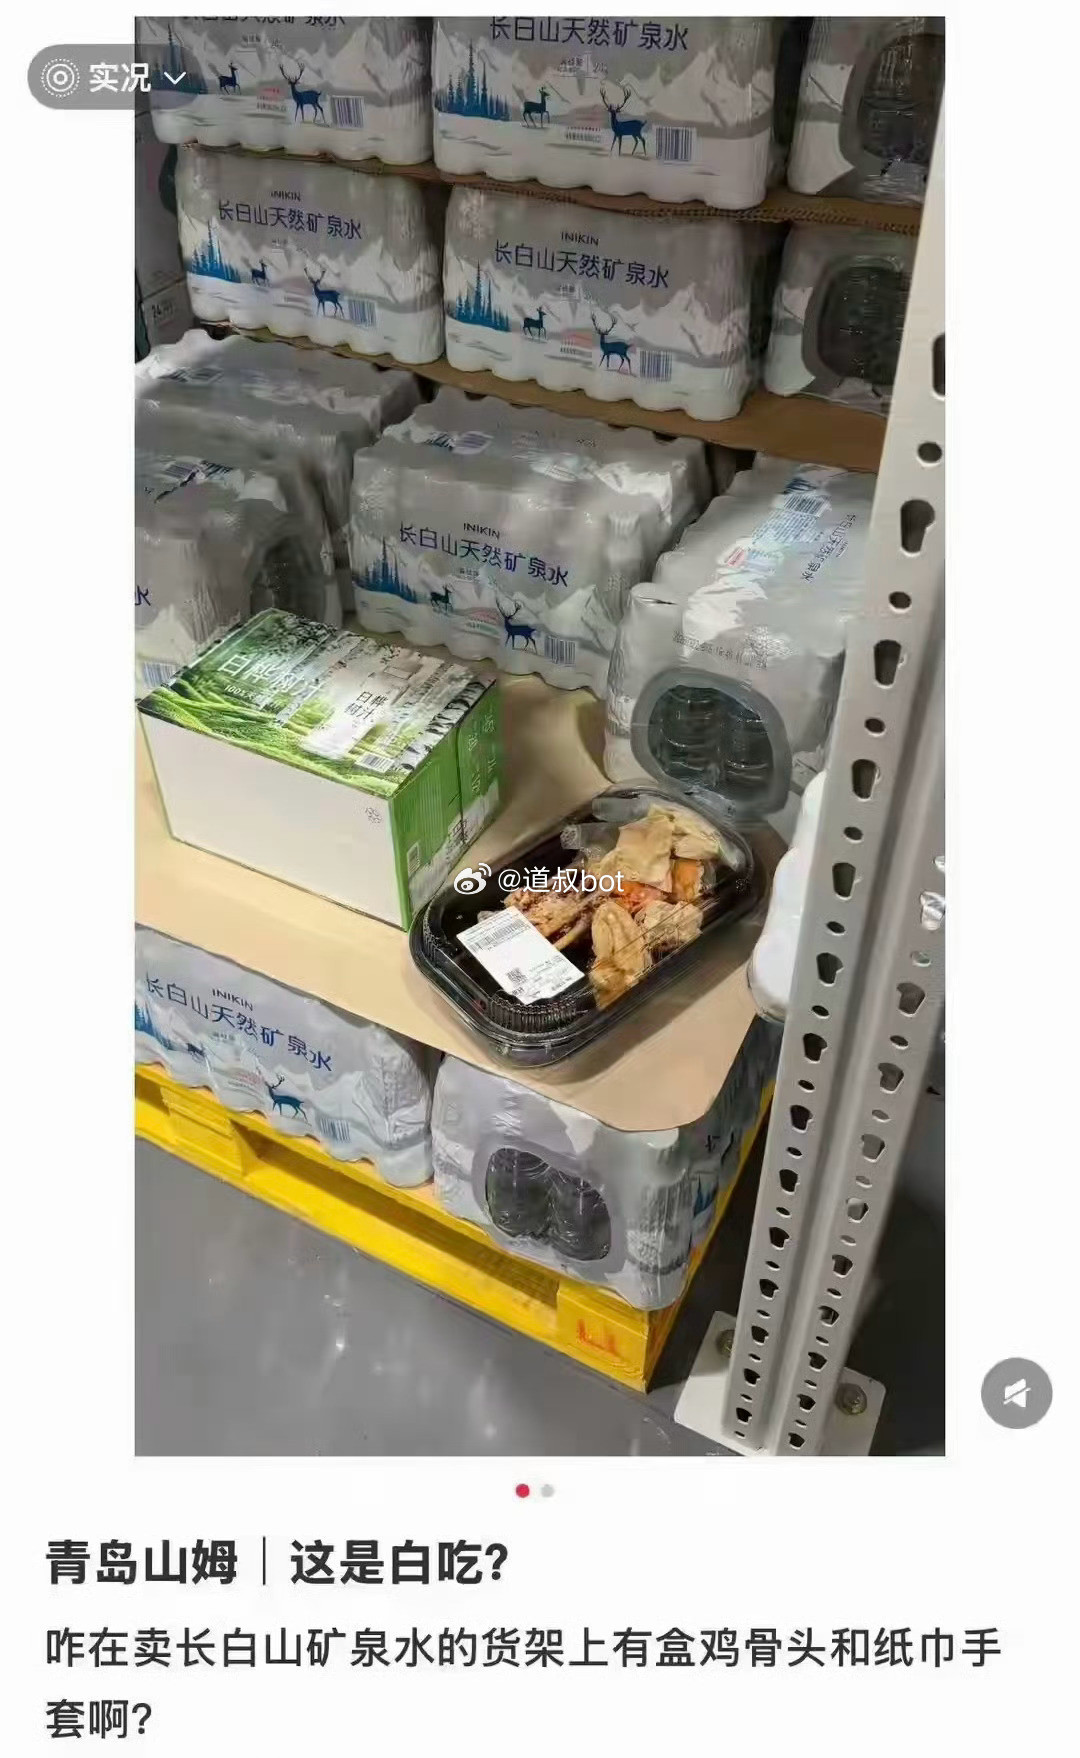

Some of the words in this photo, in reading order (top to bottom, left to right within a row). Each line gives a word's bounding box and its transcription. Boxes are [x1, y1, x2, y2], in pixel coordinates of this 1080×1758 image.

[561, 231, 599, 246] INIKIN
[494, 239, 669, 288] 长白山天然矿泉水
[463, 522, 500, 539] INIKIN
[400, 521, 569, 588] 长白山天然矿泉水
[212, 988, 254, 1011] INIKIN
[146, 972, 332, 1072] 长白山天然矿泉水
